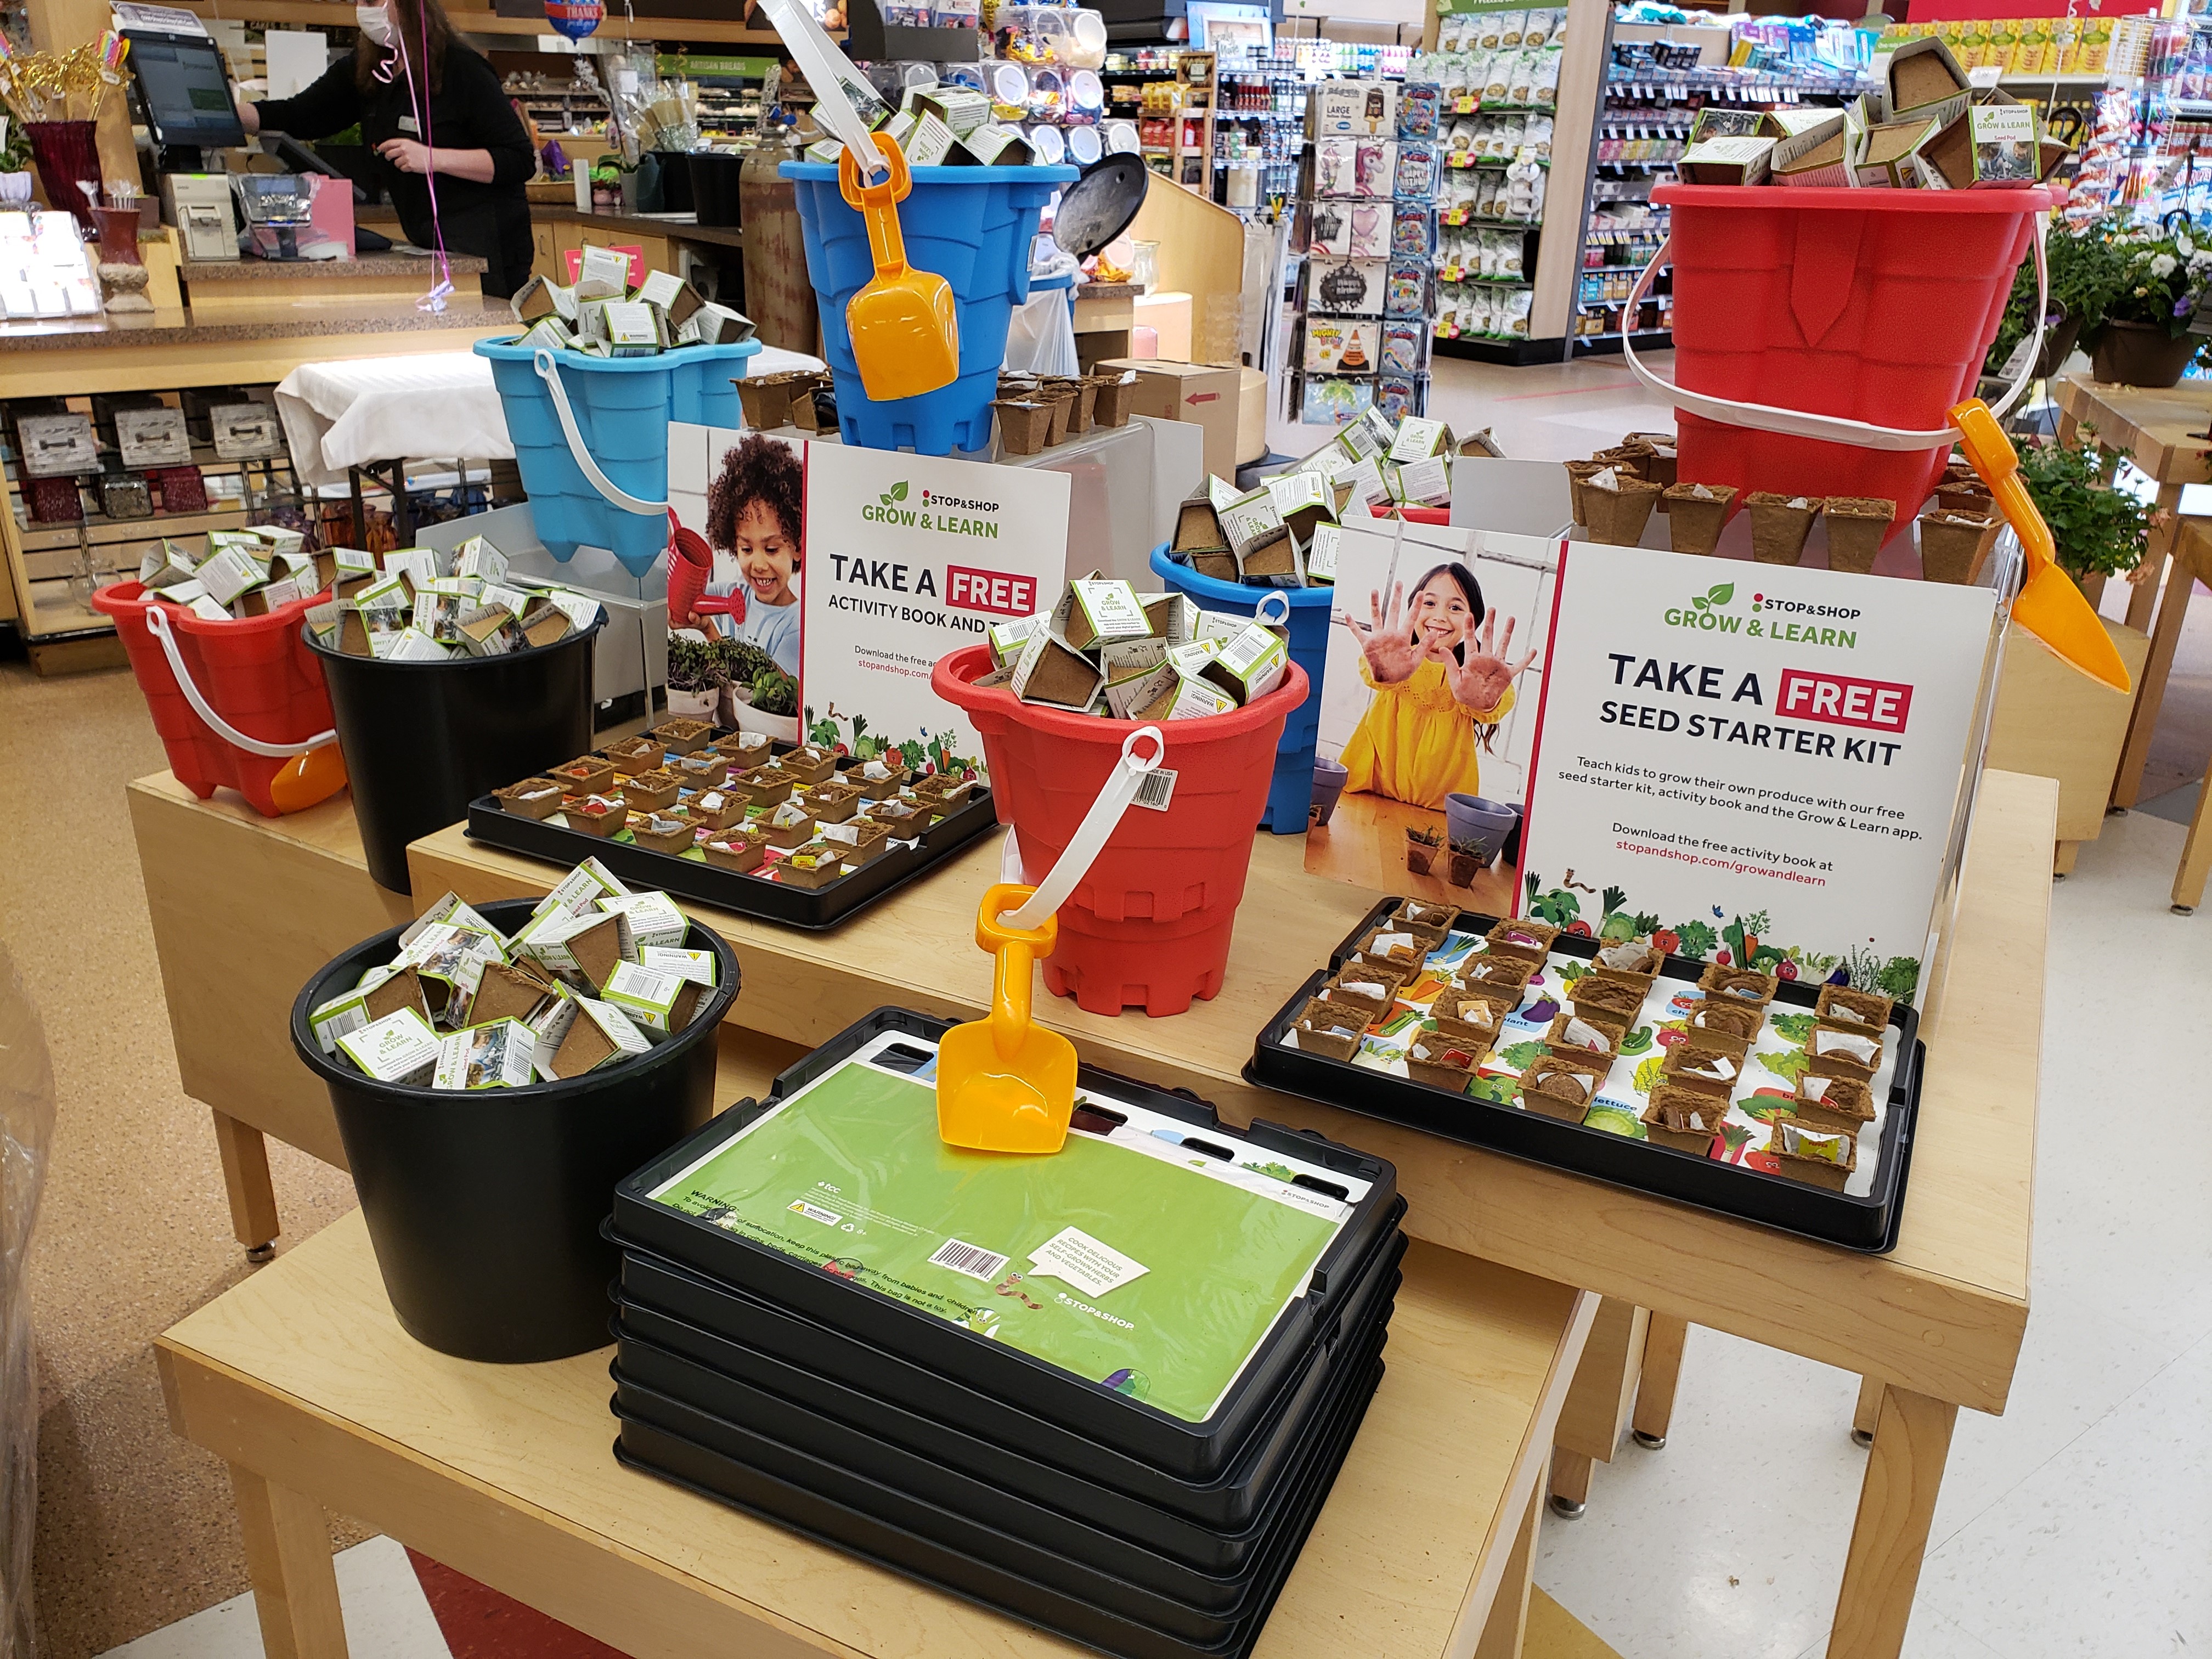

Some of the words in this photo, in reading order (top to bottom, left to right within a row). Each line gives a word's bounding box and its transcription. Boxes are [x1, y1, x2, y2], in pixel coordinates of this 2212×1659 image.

[1327, 106, 1351, 114] LARGE
[931, 495, 999, 512] STOP&SHOP
[862, 505, 916, 527] GROW
[920, 514, 933, 529] &
[937, 515, 998, 539] LEARN
[830, 553, 908, 592] TAKE
[915, 569, 937, 597] A
[952, 572, 1030, 612] FREE
[828, 594, 899, 619] ACTIVITY
[901, 607, 947, 628] BOOK
[950, 616, 985, 633] AND
[1764, 599, 1861, 620] STOP&SHOP
[1215, 619, 1237, 628] STOP&SHOP
[1664, 608, 1742, 634] GROW
[1746, 619, 1763, 637] &
[1770, 622, 1857, 649] LEARN
[855, 645, 894, 660] Download
[895, 653, 909, 663] the
[911, 656, 927, 667] free
[858, 659, 933, 679] stopandshop.com/
[1190, 692, 1214, 708] WARNING!
[1608, 653, 1724, 700] TAKE
[1731, 673, 1763, 706] A
[1786, 677, 1903, 725] FREE
[1599, 701, 1680, 732] SEED
[1686, 714, 1836, 758] STARTER
[1842, 737, 1901, 766] KIT
[1577, 756, 1612, 771] Teach
[1615, 763, 1640, 776] kids
[1643, 768, 1656, 778] to
[1659, 772, 1691, 785] grow
[1694, 776, 1726, 791] their
[1728, 784, 1755, 796] own
[1758, 788, 1814, 805] produce
[1817, 798, 1846, 810] with
[1850, 804, 1874, 815] our
[1876, 806, 1905, 820] free
[1559, 771, 1588, 783] seed
[1590, 776, 1633, 791] starter
[1636, 782, 1656, 797] kit,
[1658, 788, 1707, 806] activity
[1709, 795, 1742, 810] book
[1745, 802, 1769, 815] and
[1772, 806, 1794, 819] the
[1797, 810, 1835, 825] Grow
[1837, 816, 1846, 827] &
[1850, 819, 1889, 834] Learn
[1892, 828, 1922, 841] app.
[1612, 822, 1675, 843] Download
[1678, 834, 1699, 847] the
[1702, 839, 1728, 852] free
[1730, 845, 1781, 864] activity
[1783, 853, 1816, 868] book
[1819, 861, 1833, 872] at
[1616, 840, 1826, 887] stopandshop.com/growandlearn
[561, 871, 582, 893] STOP&SHOP
[572, 878, 592, 899] LEARN
[573, 904, 582, 916] eed
[579, 898, 589, 911] Pod
[427, 926, 447, 944] LEARN
[363, 1017, 392, 1032] STOP&SHOP
[379, 1034, 404, 1048] GROW
[388, 1036, 413, 1051] LEARN
[453, 1035, 462, 1060] LEARN
[1594, 1097, 1638, 1111] lettuce
[824, 1183, 842, 1194] tcc
[691, 1189, 740, 1212] WARNING:
[1287, 1192, 1329, 1209] STOP&SHOP
[808, 1207, 836, 1221] WARNING!
[693, 1202, 711, 1210] avoid
[746, 1221, 785, 1242] suffocation,
[787, 1238, 805, 1249] keep
[806, 1245, 820, 1255] this
[820, 1252, 844, 1266] plastic
[882, 1273, 900, 1285] from
[900, 1281, 926, 1295] babies
[927, 1291, 944, 1300] and
[1057, 1239, 1085, 1256] RECIPES
[1083, 1255, 1102, 1268] WITH
[1101, 1264, 1120, 1278] YOUR
[1068, 1237, 1089, 1251] COOK
[1087, 1249, 1123, 1271] DELICIOUS
[1046, 1249, 1062, 1260] AND
[1061, 1257, 1102, 1286] VEGETABLES.
[1049, 1243, 1092, 1271] SELF-GROWN
[1092, 1268, 1114, 1284] HERBS
[871, 1280, 887, 1292] This
[888, 1289, 902, 1299] bag
[912, 1297, 926, 1306] not
[1064, 1297, 1135, 1330] STOP&SHOP
